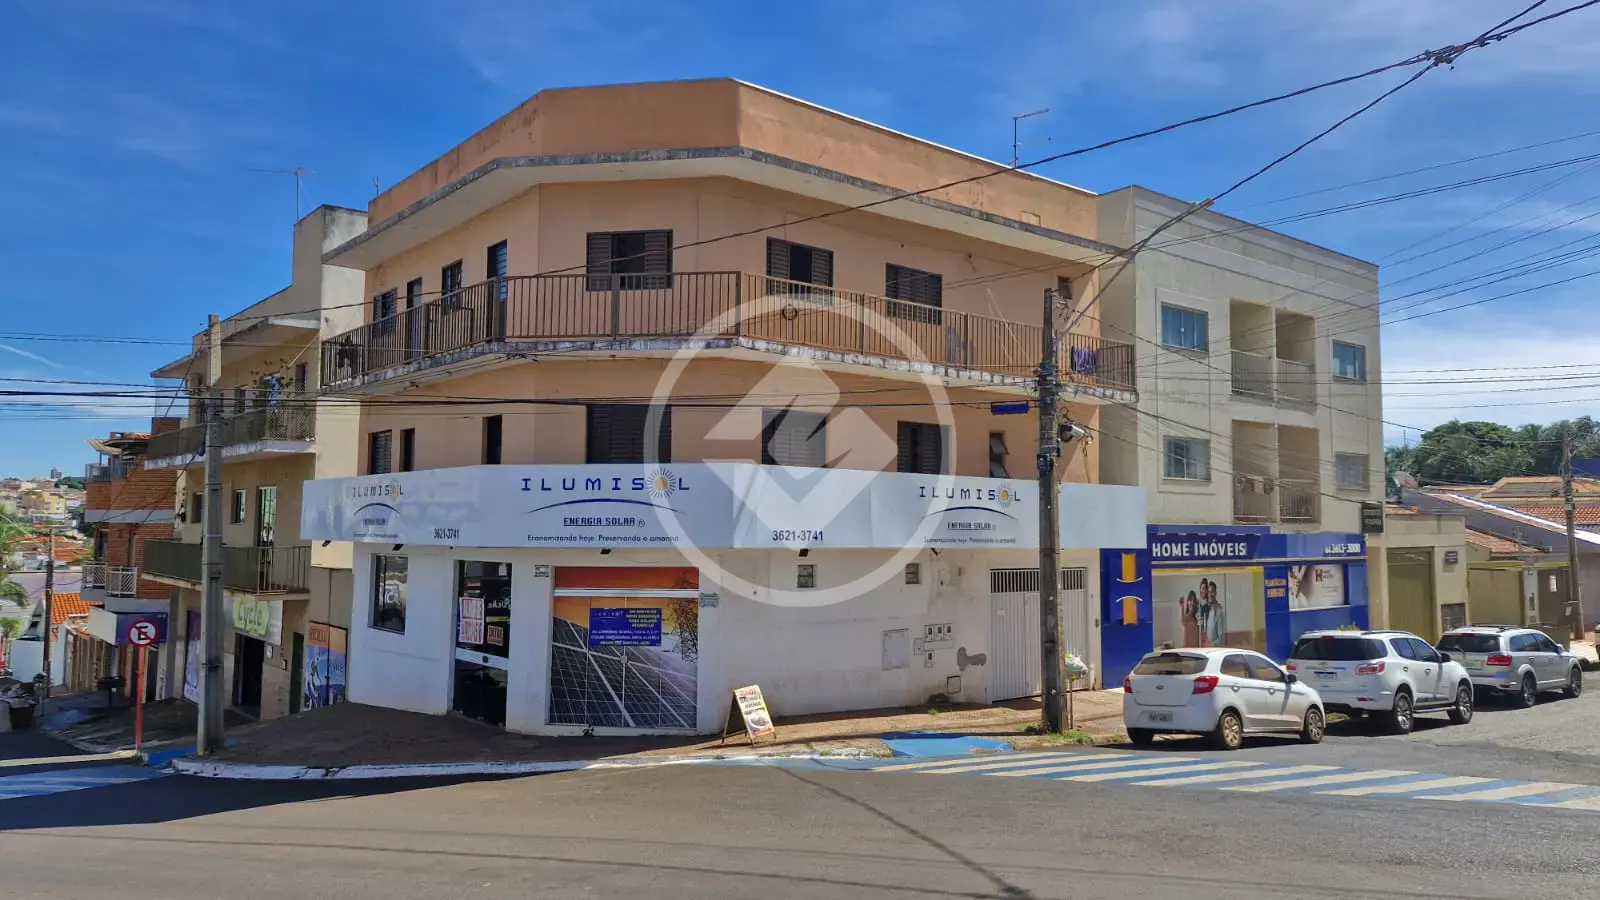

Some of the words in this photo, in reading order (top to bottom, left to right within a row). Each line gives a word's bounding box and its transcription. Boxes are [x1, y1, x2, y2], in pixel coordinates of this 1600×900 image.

[521, 469, 690, 498] ILUMISOL
[605, 517, 635, 527] SOLAR
[433, 528, 460, 540] 3621-3741
[772, 529, 824, 542] 3621-3741
[1152, 543, 1190, 557] HOME
[1194, 539, 1247, 557] IMÓVEIS
[137, 626, 148, 641] E
